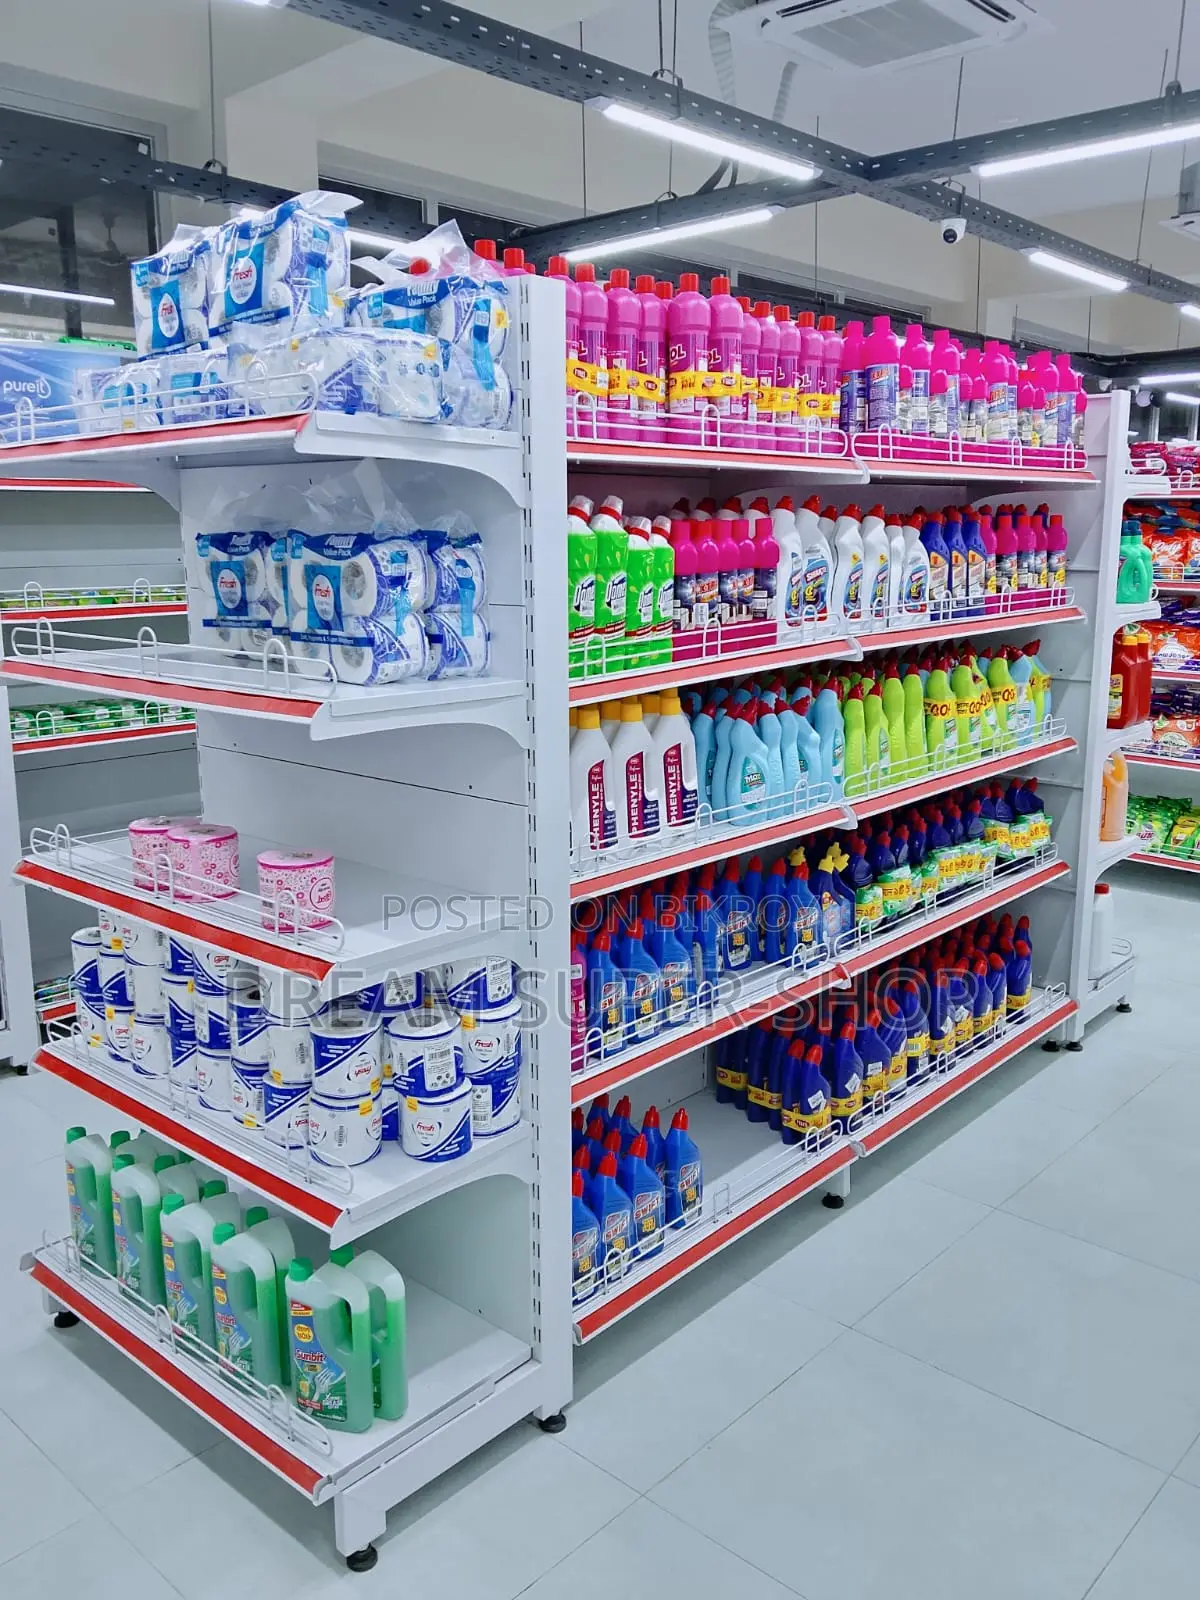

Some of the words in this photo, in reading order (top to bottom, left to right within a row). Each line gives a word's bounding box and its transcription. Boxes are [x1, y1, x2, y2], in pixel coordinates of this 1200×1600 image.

[3, 377, 51, 398] pureit
[667, 765, 678, 824] PHENYLE
[416, 1122, 435, 1132] Fresh
